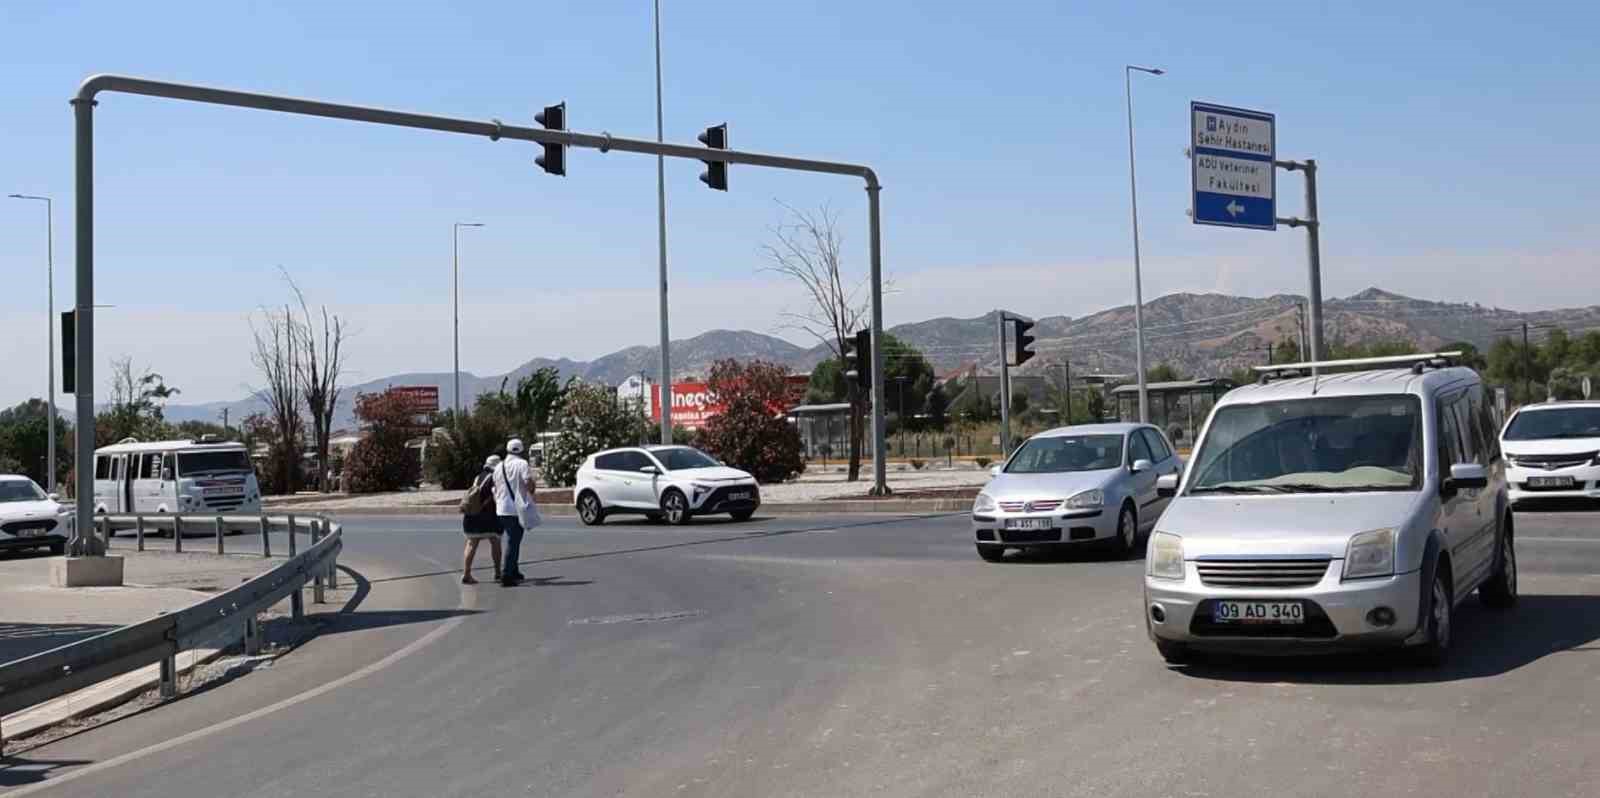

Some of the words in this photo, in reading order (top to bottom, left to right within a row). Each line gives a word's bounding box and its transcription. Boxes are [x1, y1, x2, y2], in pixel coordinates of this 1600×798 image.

[1225, 136, 1270, 153] Hastanesi
[1221, 603, 1239, 618] 09
[1246, 604, 1266, 618] AD
[1271, 603, 1301, 618] 340
